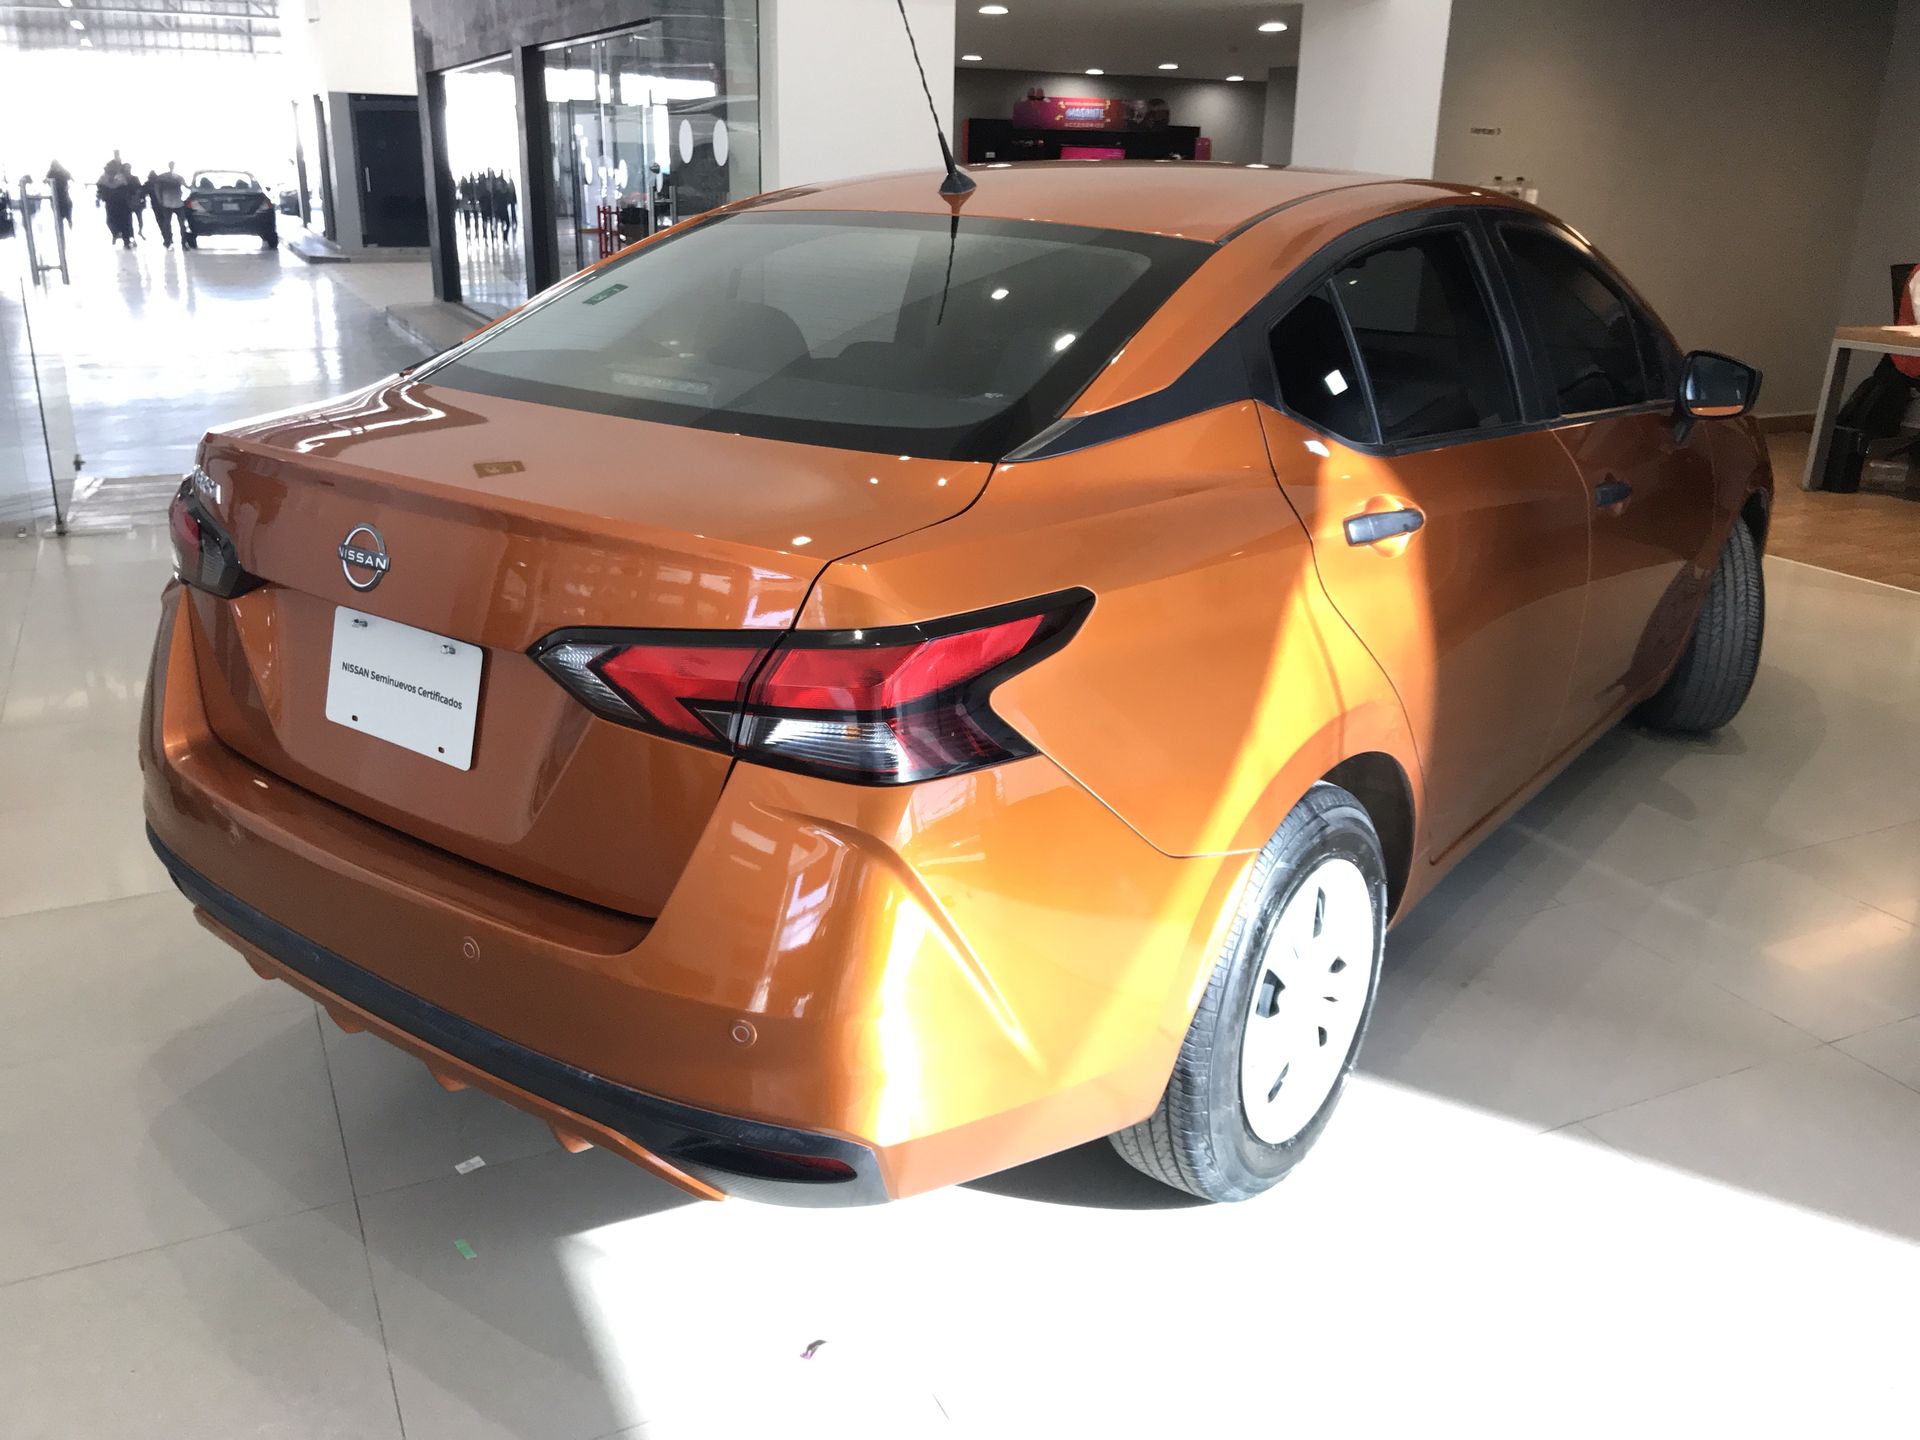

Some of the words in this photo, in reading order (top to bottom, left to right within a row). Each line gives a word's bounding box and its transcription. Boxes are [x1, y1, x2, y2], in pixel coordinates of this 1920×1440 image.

[338, 545, 387, 570] NISSAN
[341, 661, 369, 679] NISSAN
[370, 670, 416, 694] Seminuevos
[417, 686, 463, 710] Certificados
